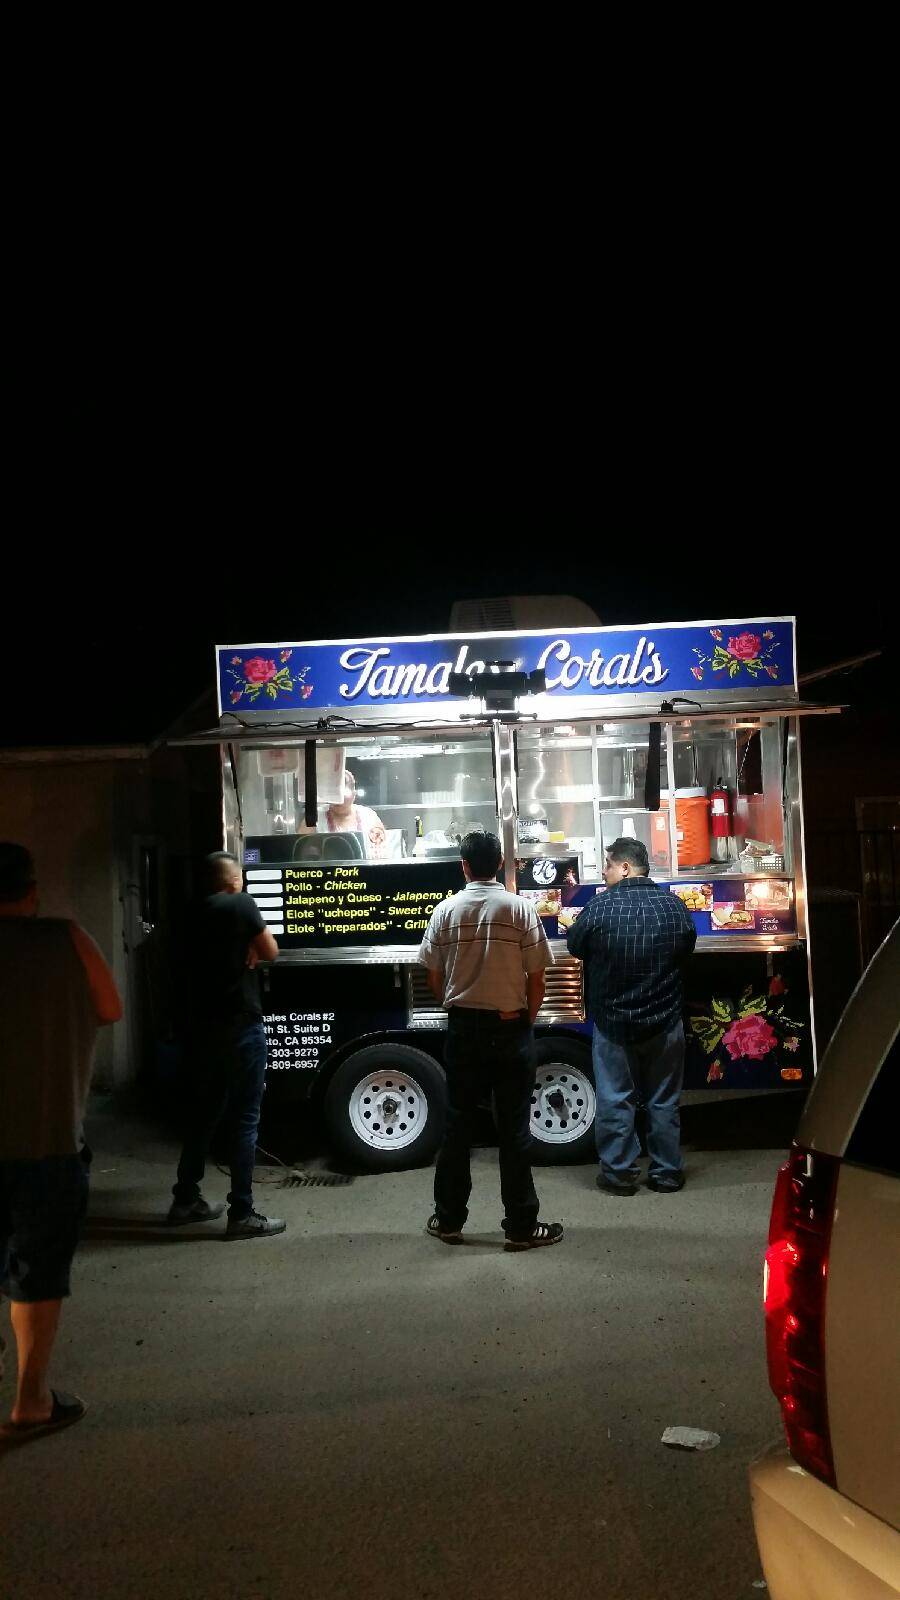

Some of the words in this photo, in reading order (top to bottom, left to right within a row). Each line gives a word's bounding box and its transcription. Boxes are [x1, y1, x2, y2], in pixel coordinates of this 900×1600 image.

[339, 645, 500, 698] Tamal
[537, 637, 669, 689] Coral's
[285, 869, 324, 879] Puerco
[334, 867, 360, 877] Pork
[285, 882, 313, 892] Pollo
[324, 880, 367, 891] Chicken
[286, 895, 336, 906] Jalapeno
[338, 896, 344, 905] y
[347, 893, 382, 903] Queso
[392, 891, 443, 902] Jalapeno
[286, 909, 315, 919] Elote
[318, 907, 376, 919] "uchepos"
[387, 905, 422, 916] Sweet
[287, 924, 315, 934] Elote
[318, 920, 393, 934] "preparados"
[404, 919, 428, 930] Grill
[289, 1012, 321, 1021] Corals
[322, 1012, 335, 1021] #2
[277, 1025, 291, 1034] St.
[293, 1024, 320, 1033] Suite
[322, 1023, 331, 1032] D
[284, 1036, 299, 1045] CA
[301, 1035, 332, 1045] 95354
